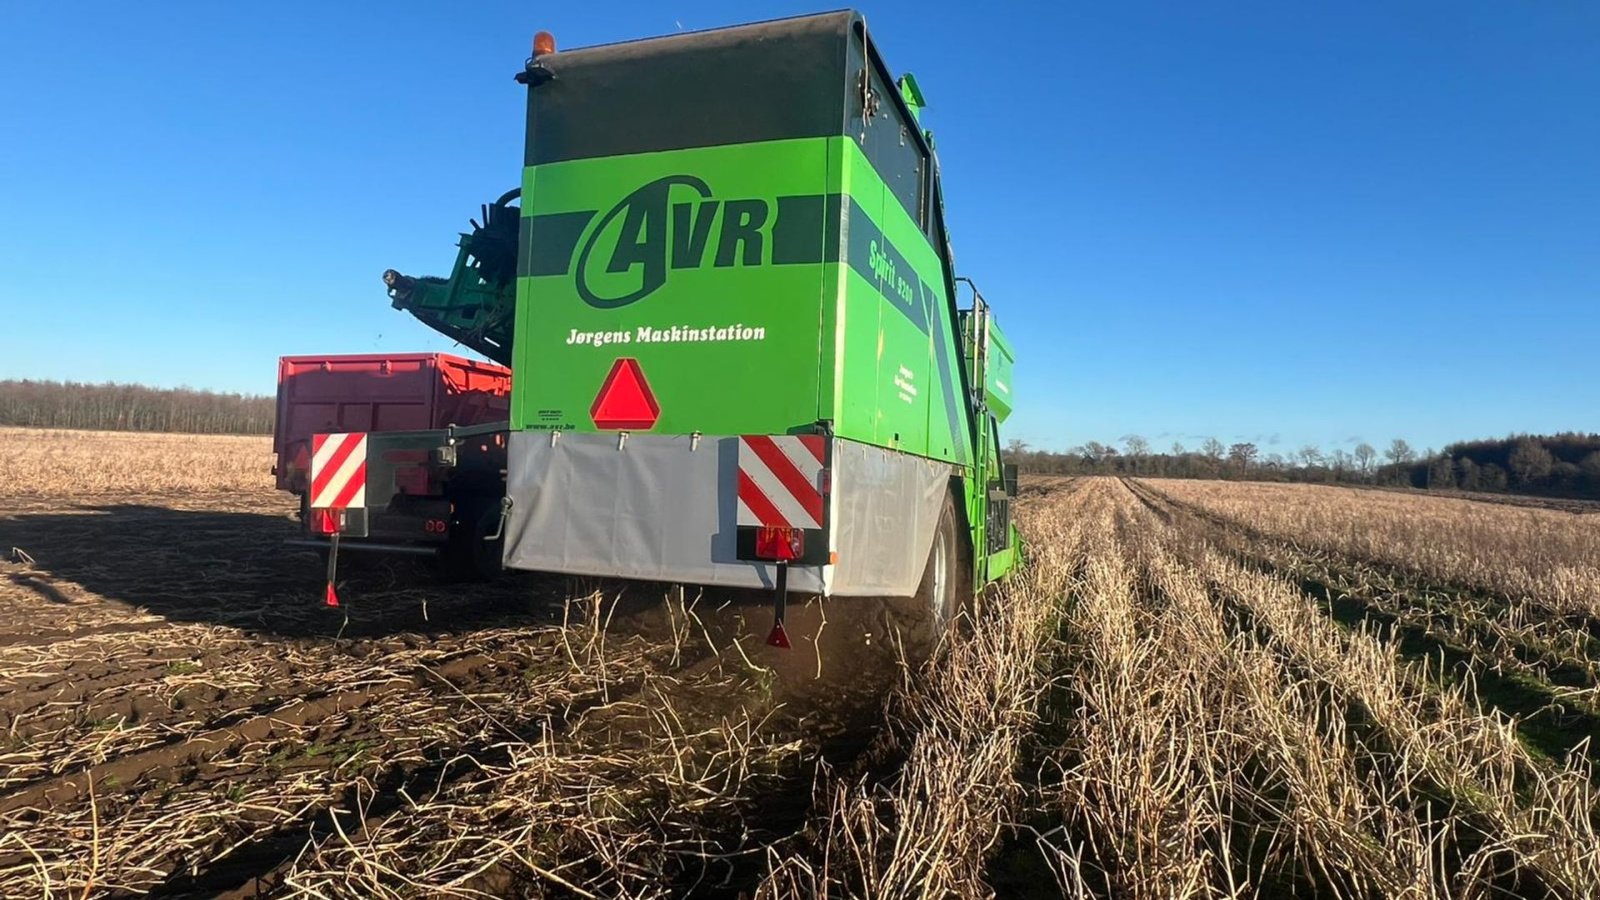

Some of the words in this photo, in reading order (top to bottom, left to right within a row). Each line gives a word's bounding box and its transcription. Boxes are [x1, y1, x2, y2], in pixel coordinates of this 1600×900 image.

[575, 174, 770, 309] AVR
[869, 239, 896, 289] Spirit
[566, 327, 631, 347] Jørgens
[636, 323, 766, 344] Maskinstation
